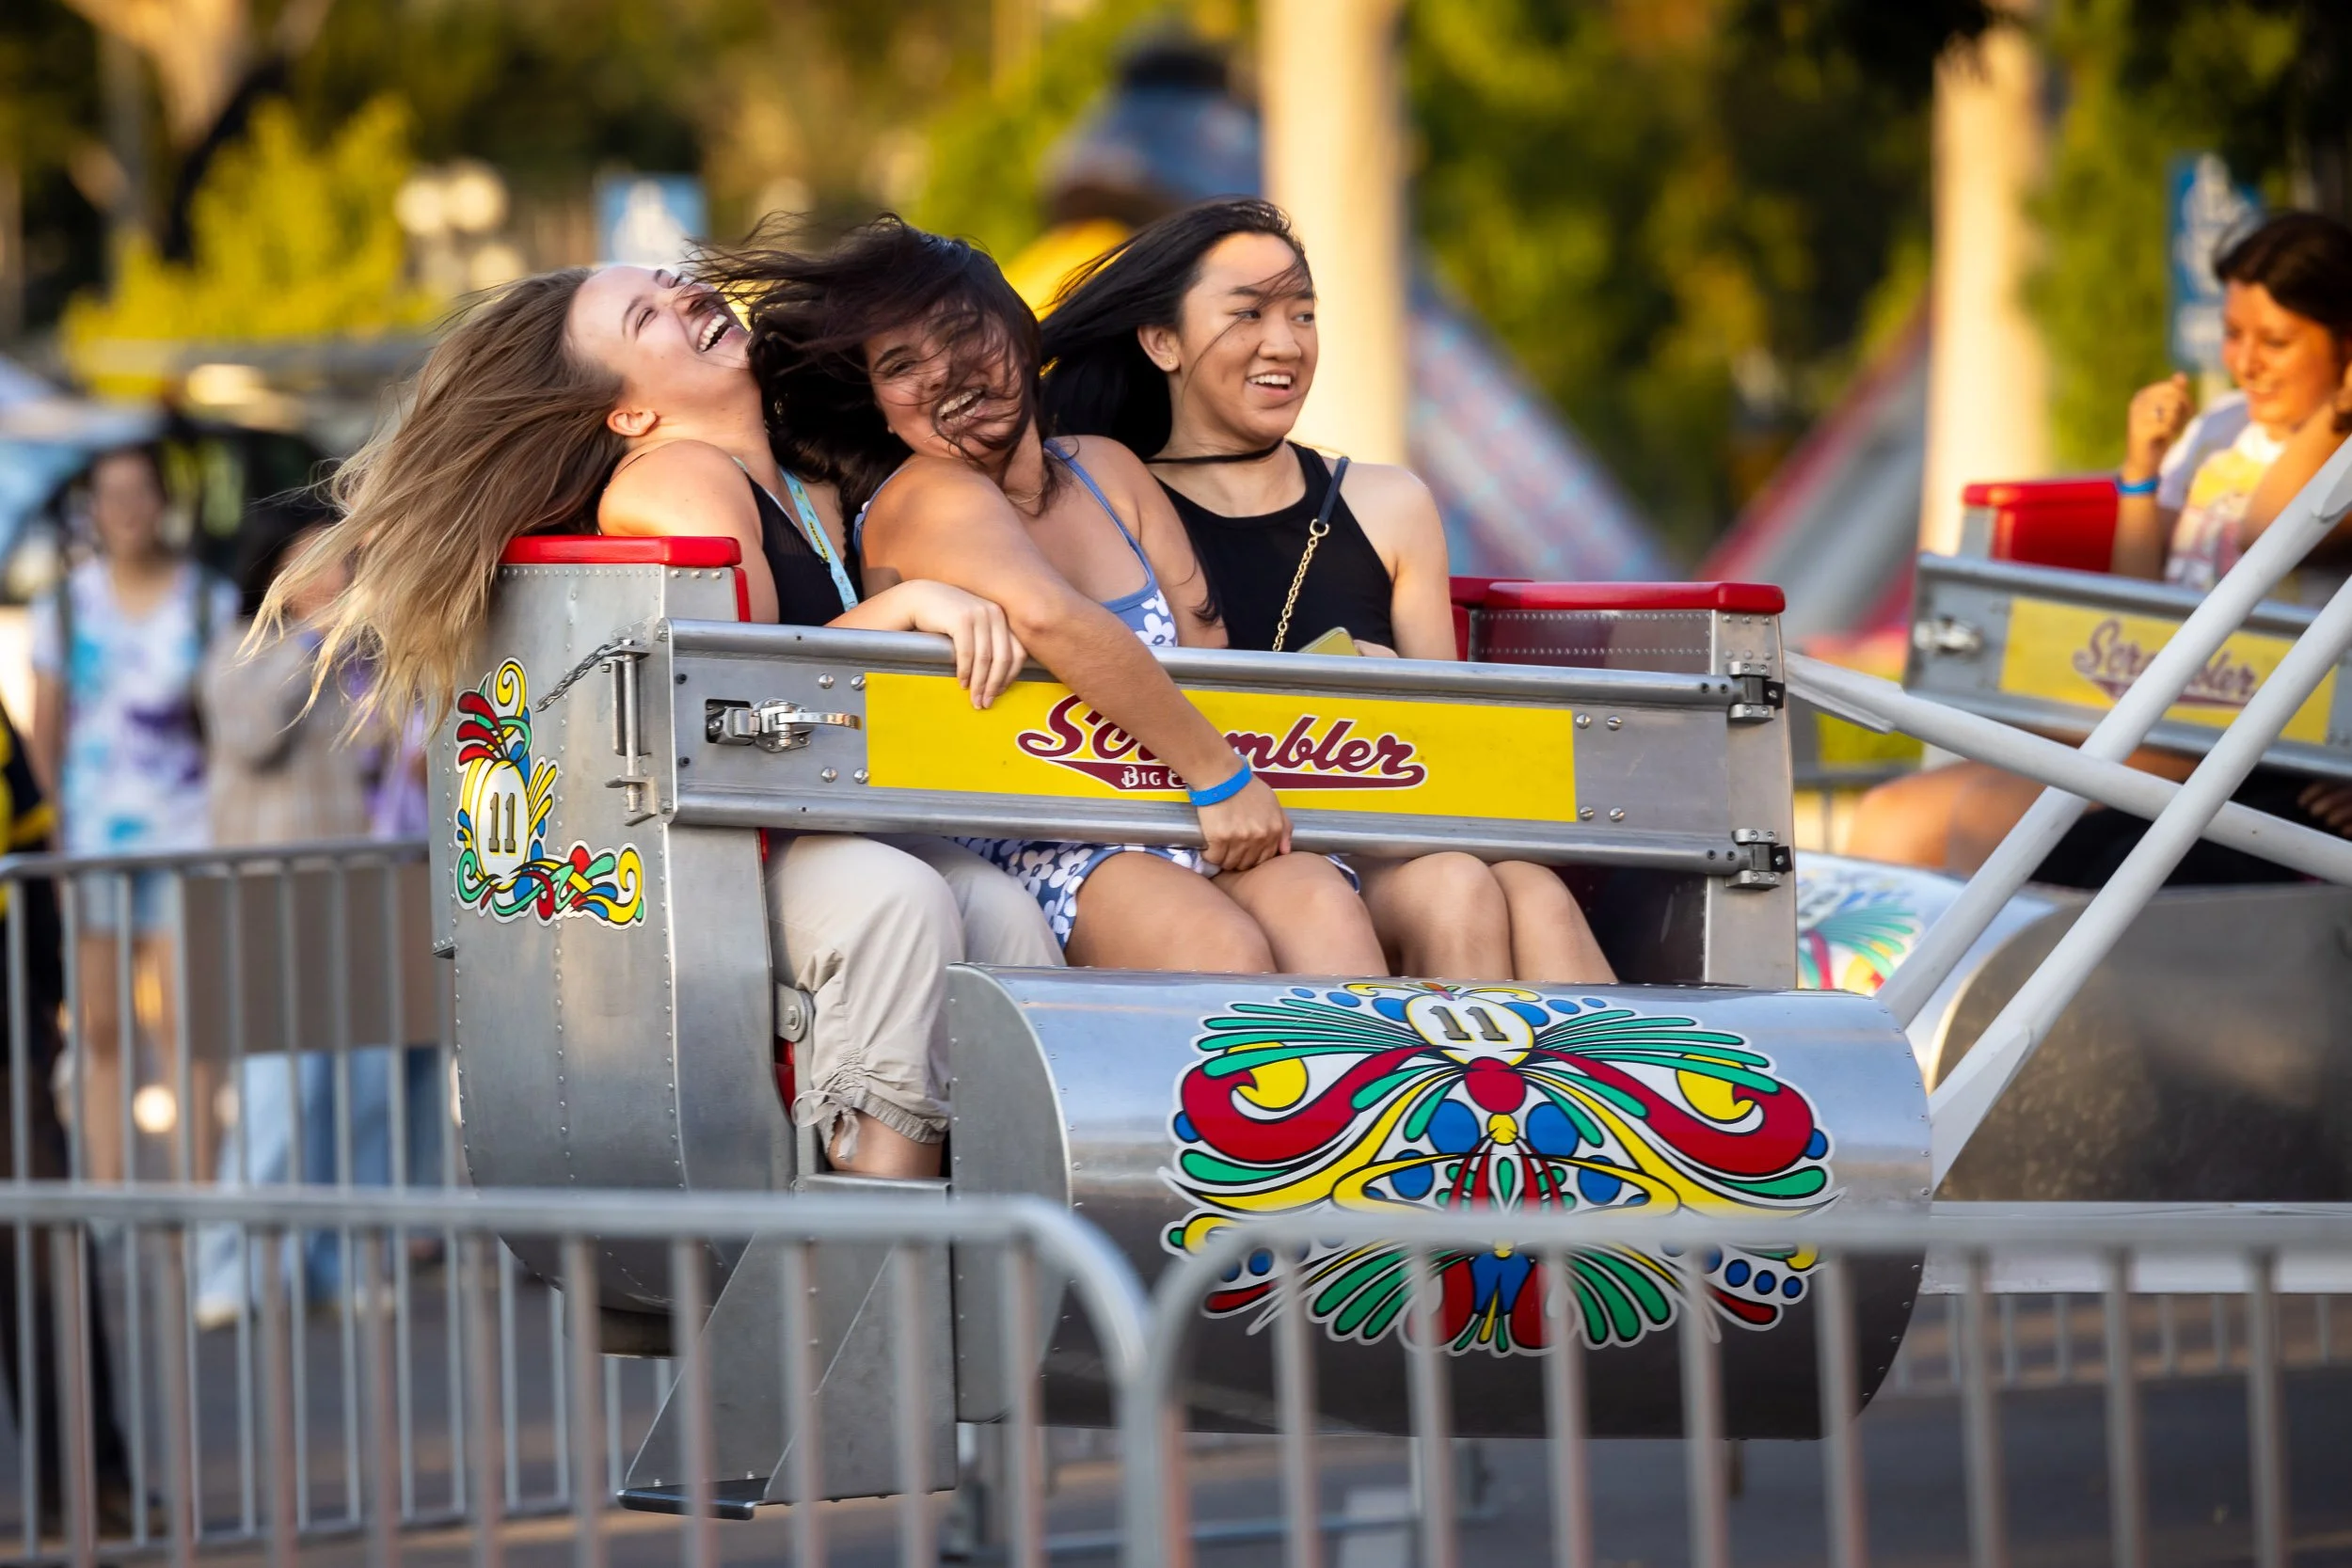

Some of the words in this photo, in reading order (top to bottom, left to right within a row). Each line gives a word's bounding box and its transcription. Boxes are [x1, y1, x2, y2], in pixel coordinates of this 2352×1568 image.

[2073, 618, 2256, 698] Scrler
[1017, 693, 1426, 777] Scmbler
[488, 792, 516, 853] 11
[1429, 1005, 1510, 1041] 11
